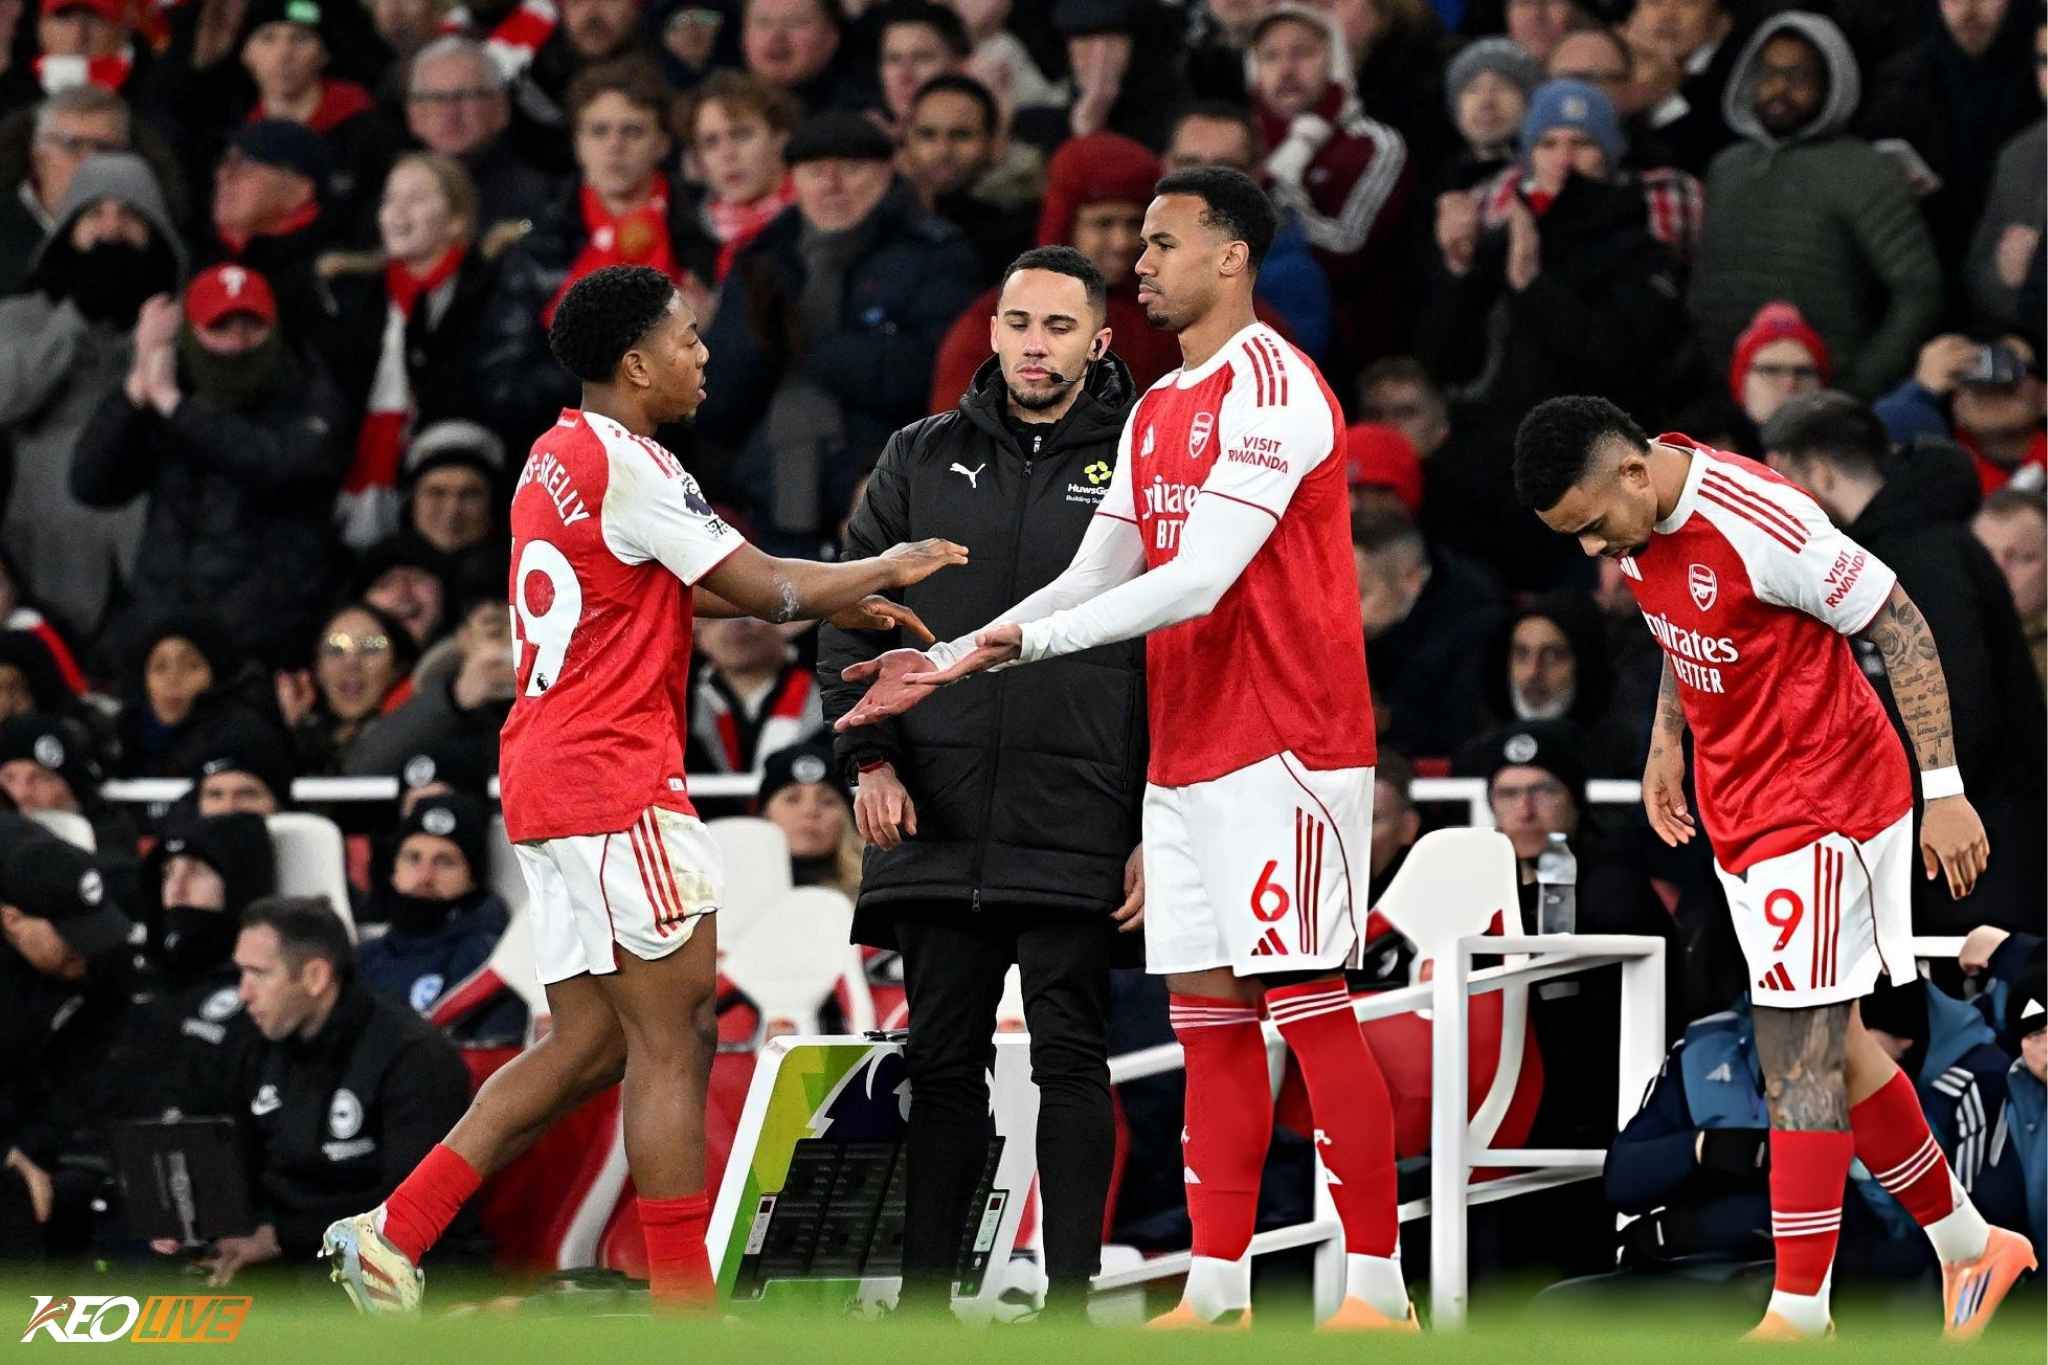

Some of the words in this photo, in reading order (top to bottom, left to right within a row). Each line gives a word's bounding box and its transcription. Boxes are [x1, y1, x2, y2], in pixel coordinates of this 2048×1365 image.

[1228, 449, 1288, 473] RWANDA
[1243, 436, 1282, 453] VISIT
[1824, 550, 1851, 584] VISIT
[1641, 611, 1739, 663] mirates
[1250, 860, 1290, 922] 6
[1764, 888, 1804, 951] 9
